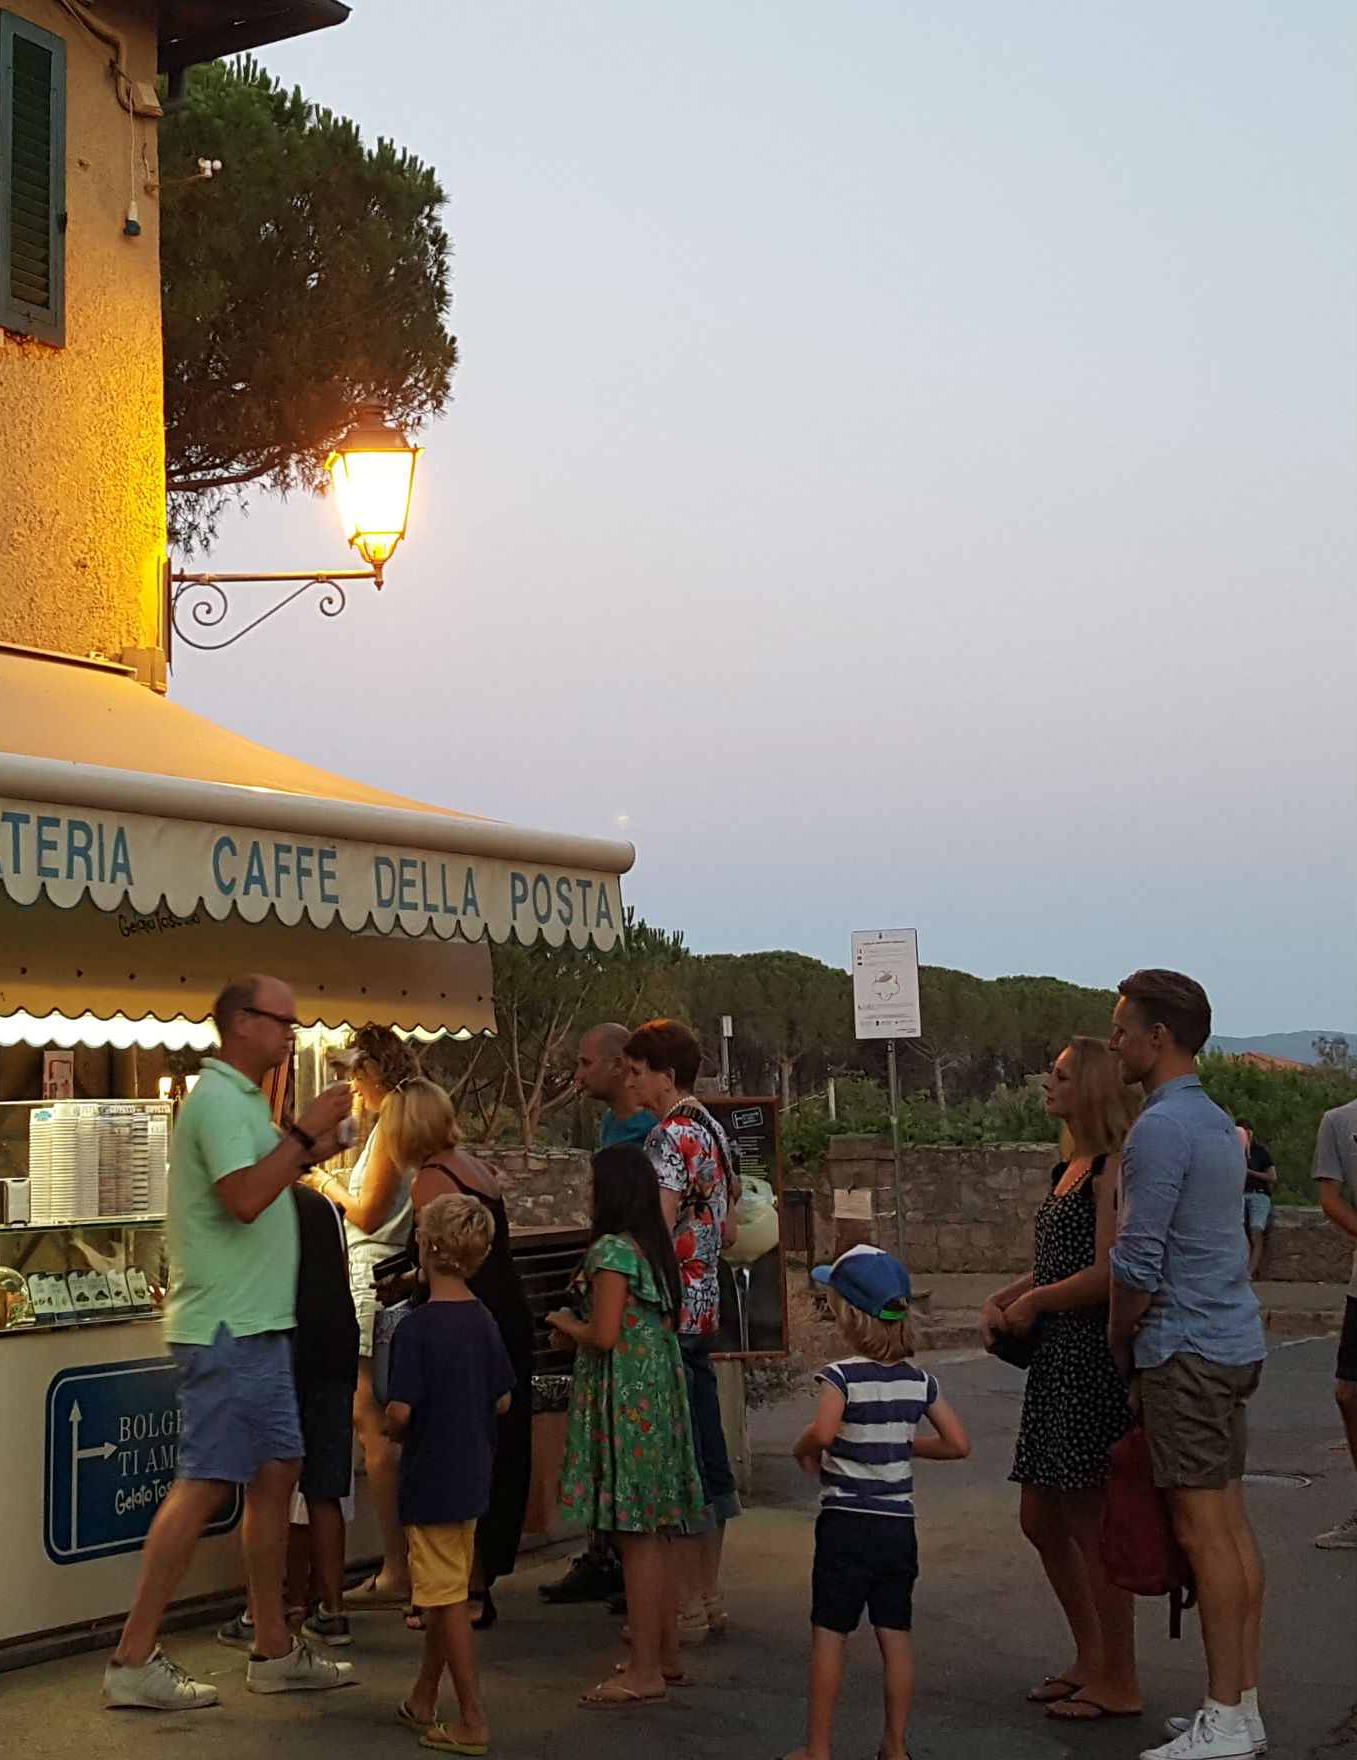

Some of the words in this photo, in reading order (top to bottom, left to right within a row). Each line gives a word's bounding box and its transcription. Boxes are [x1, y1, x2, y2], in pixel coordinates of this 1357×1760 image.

[374, 856, 480, 918] DELLA
[510, 872, 614, 929] POSTA
[118, 1450, 139, 1477] TI
[145, 1444, 181, 1474] AM
